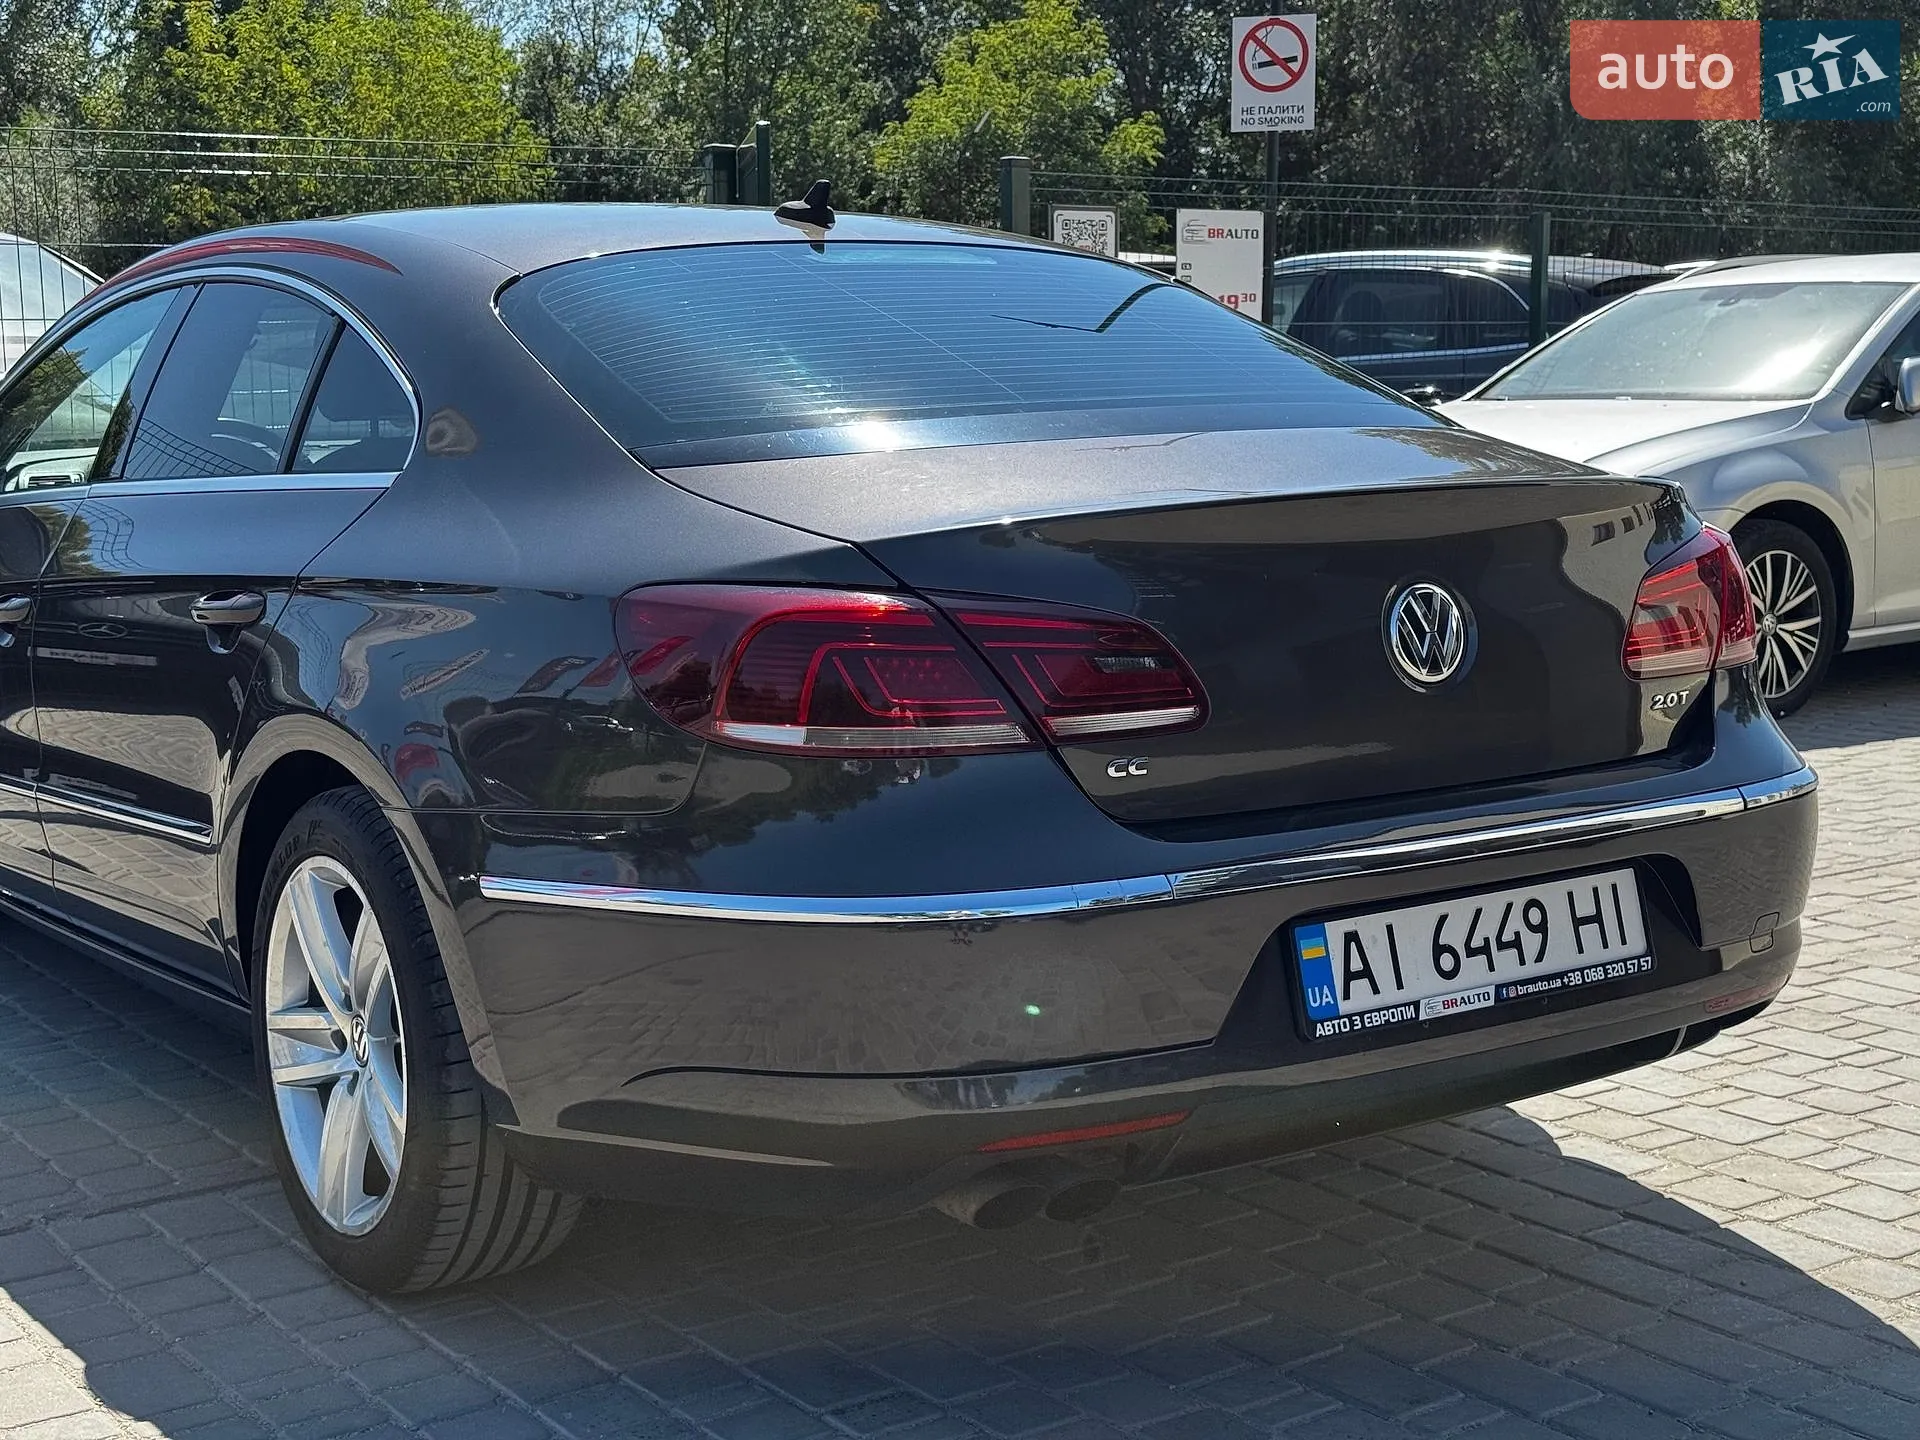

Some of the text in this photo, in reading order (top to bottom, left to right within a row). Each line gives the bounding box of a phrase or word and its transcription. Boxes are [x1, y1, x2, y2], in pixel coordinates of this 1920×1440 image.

[1241, 104, 1305, 116] НЕ ПАЛИТИ
[1241, 115, 1305, 126] NO SMOKING
[1207, 228, 1259, 240] BRAUTO
[1107, 757, 1149, 778] CC
[1342, 883, 1628, 1002] AI 6449 HI
[1517, 956, 1652, 995] brauto.ua +38 068 320 57 57
[1308, 984, 1334, 1008] UA
[1442, 991, 1491, 1010] BRAUTO
[1315, 1018, 1350, 1038] АВТО
[1364, 1005, 1416, 1028] ЄВРОПИ
